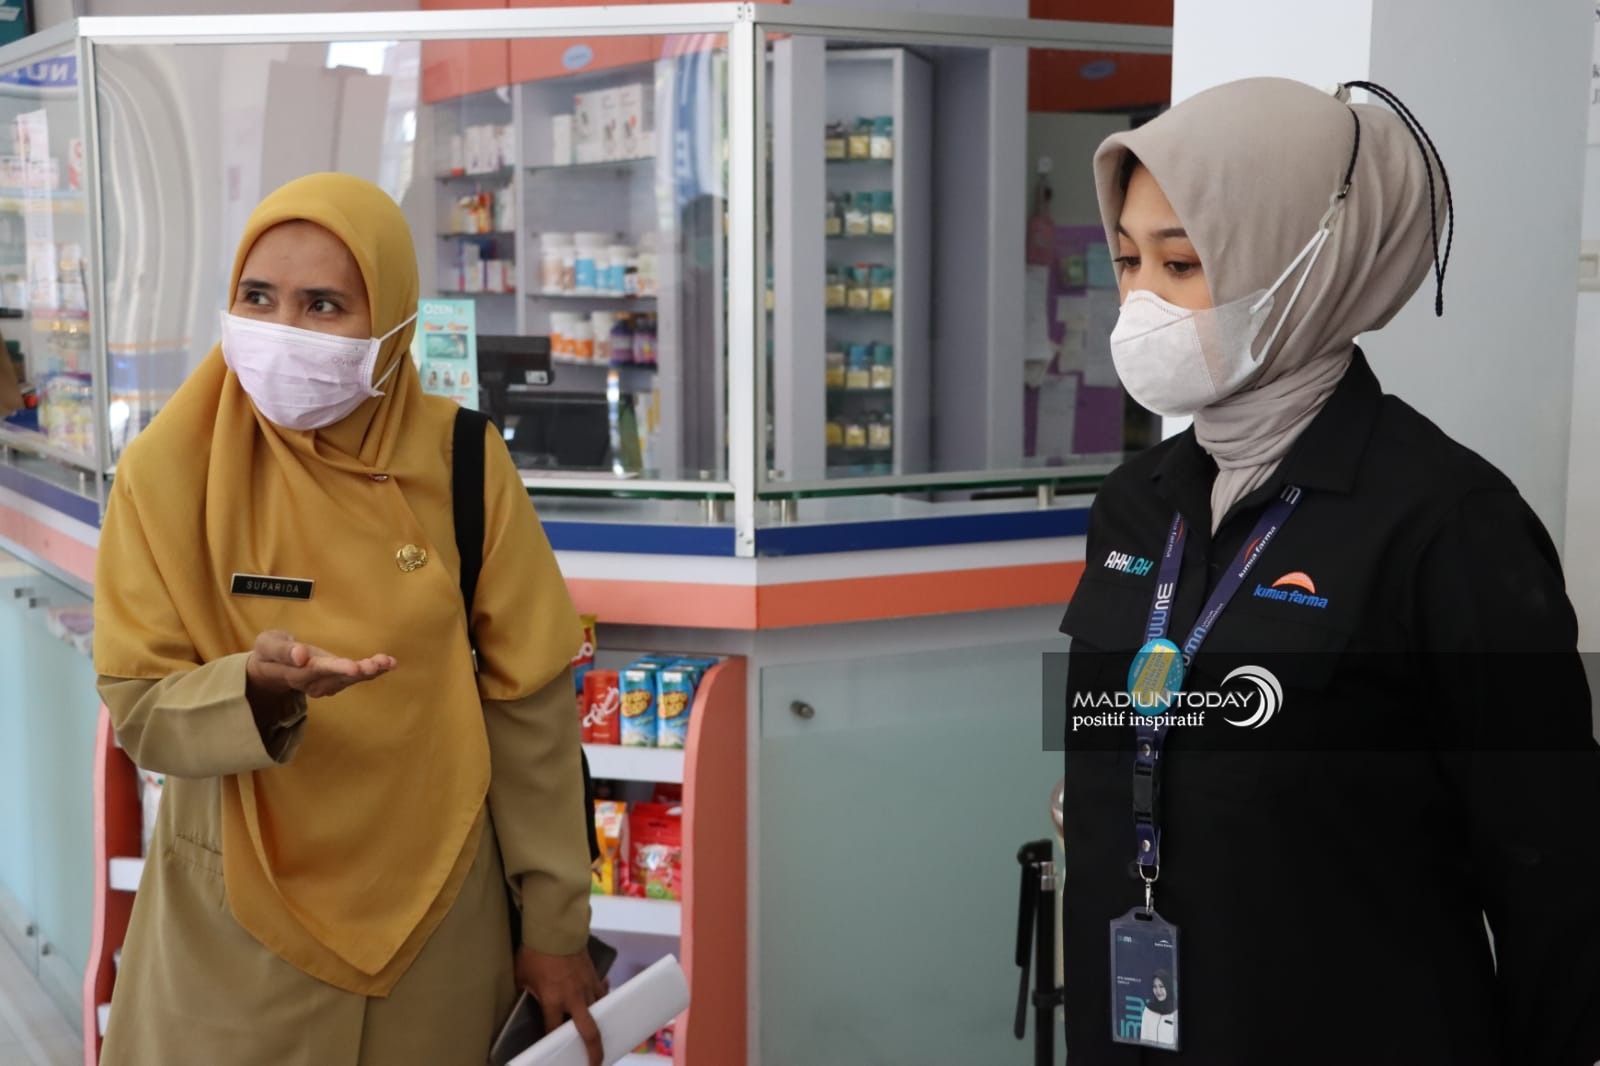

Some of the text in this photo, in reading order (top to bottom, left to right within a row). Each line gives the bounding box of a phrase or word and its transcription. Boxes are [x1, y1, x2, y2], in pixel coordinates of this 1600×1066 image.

[246, 580, 300, 594] SUPARIDA
[1253, 583, 1329, 609] kimia farma
